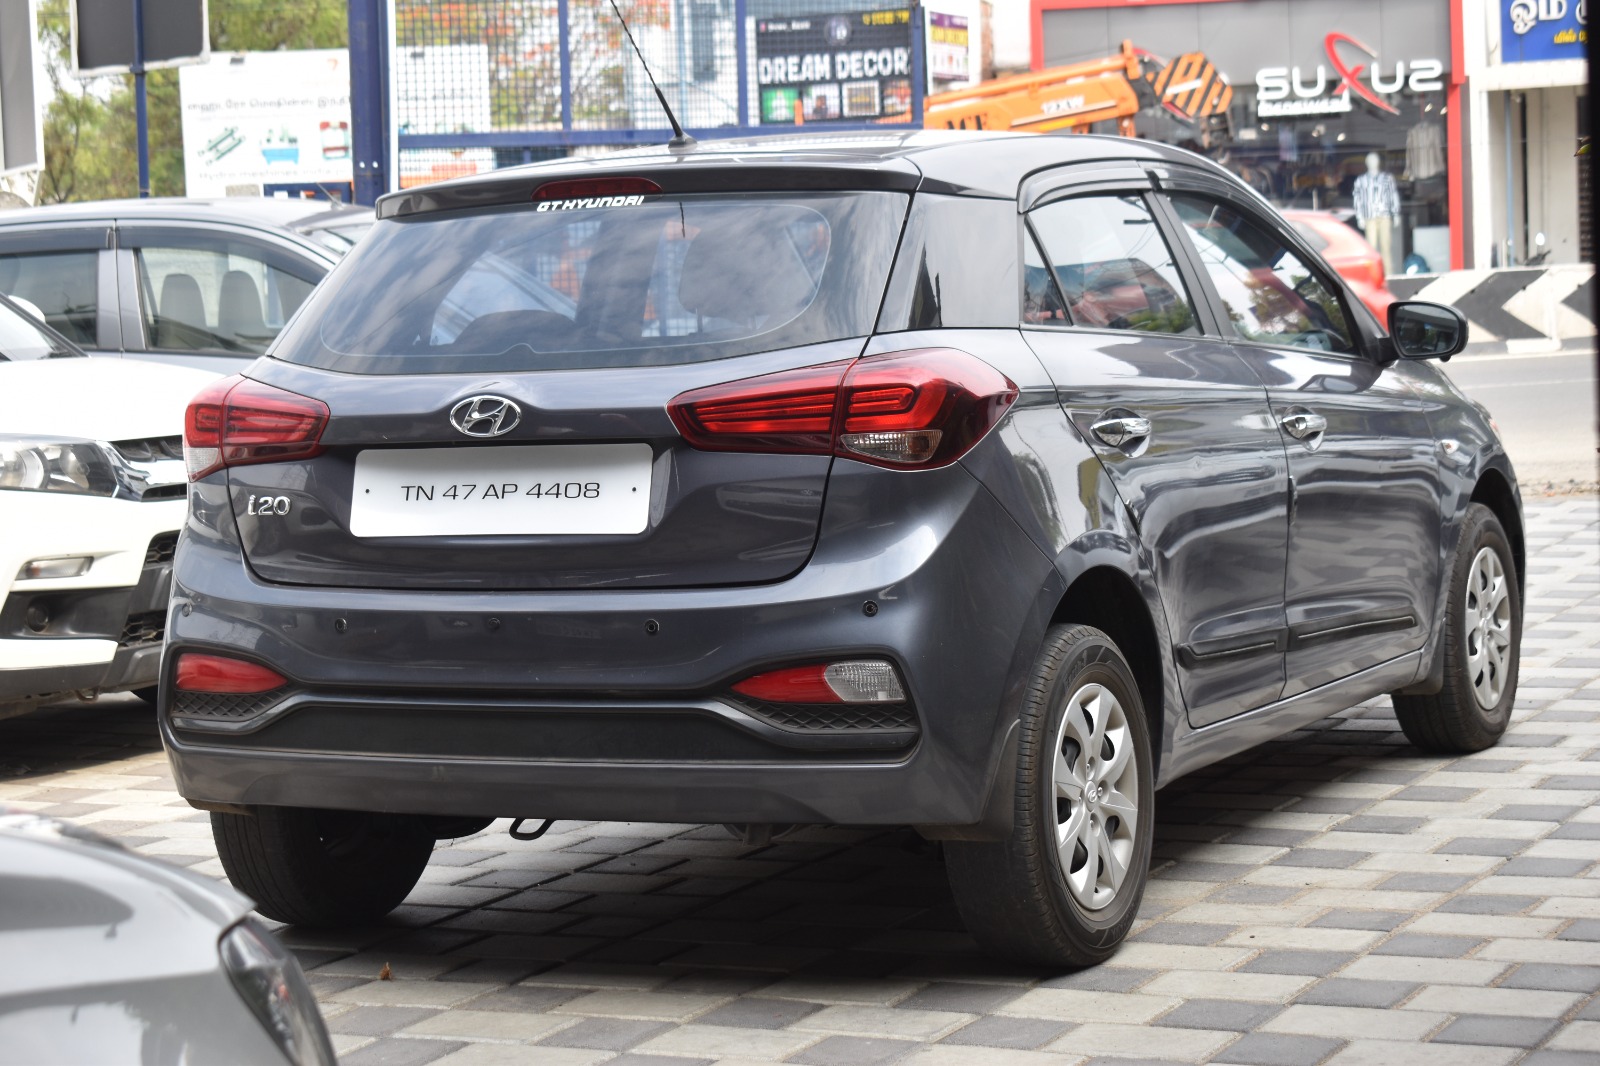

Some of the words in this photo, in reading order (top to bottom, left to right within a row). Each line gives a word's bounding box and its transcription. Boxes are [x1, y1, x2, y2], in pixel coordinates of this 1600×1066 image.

[758, 53, 831, 84] DREAM
[835, 47, 911, 79] DECOR
[401, 485, 435, 501] TN
[442, 484, 477, 501] 47
[482, 483, 518, 500] AP
[525, 482, 601, 499] 4408
[248, 494, 291, 516] i20
